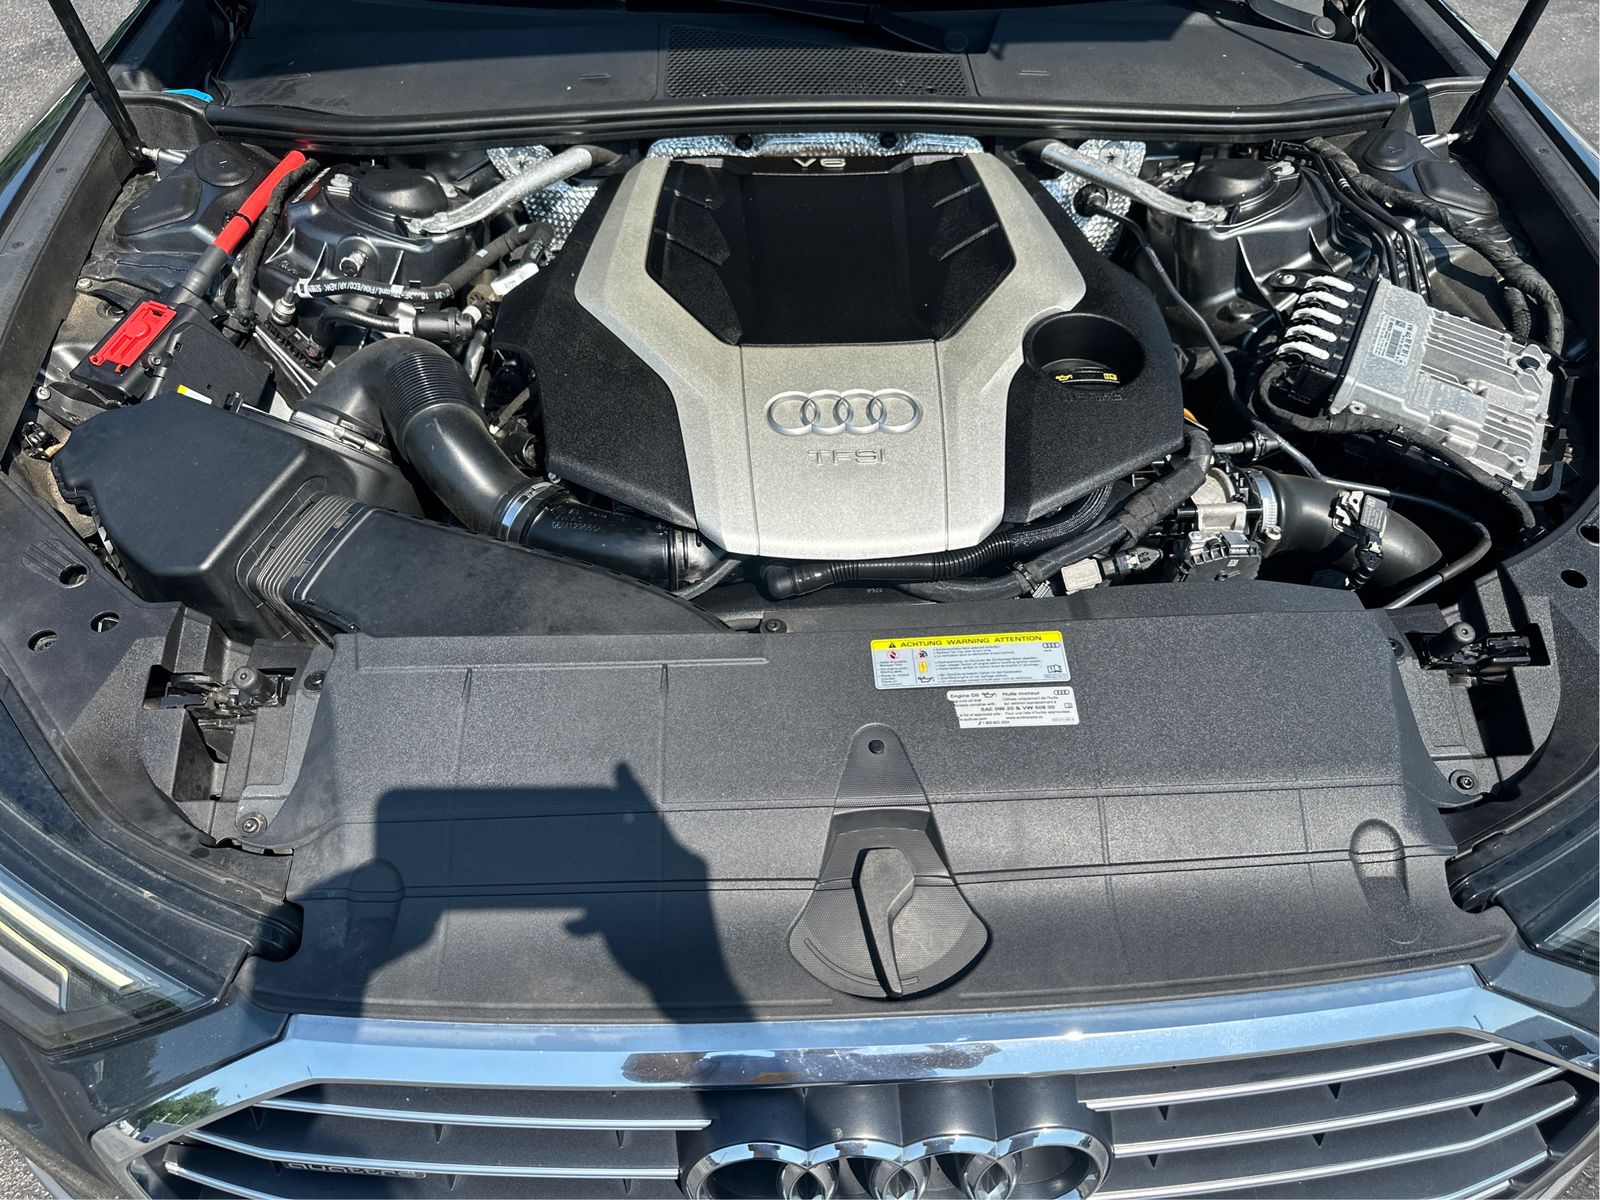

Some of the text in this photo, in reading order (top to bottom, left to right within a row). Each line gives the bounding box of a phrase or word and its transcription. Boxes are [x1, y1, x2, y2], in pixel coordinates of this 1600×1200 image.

[793, 158, 846, 168] V6
[807, 448, 887, 464] TFSI
[946, 637, 990, 645] WARNING
[994, 635, 1042, 643] ATTENTION
[288, 1162, 417, 1177] quattro
